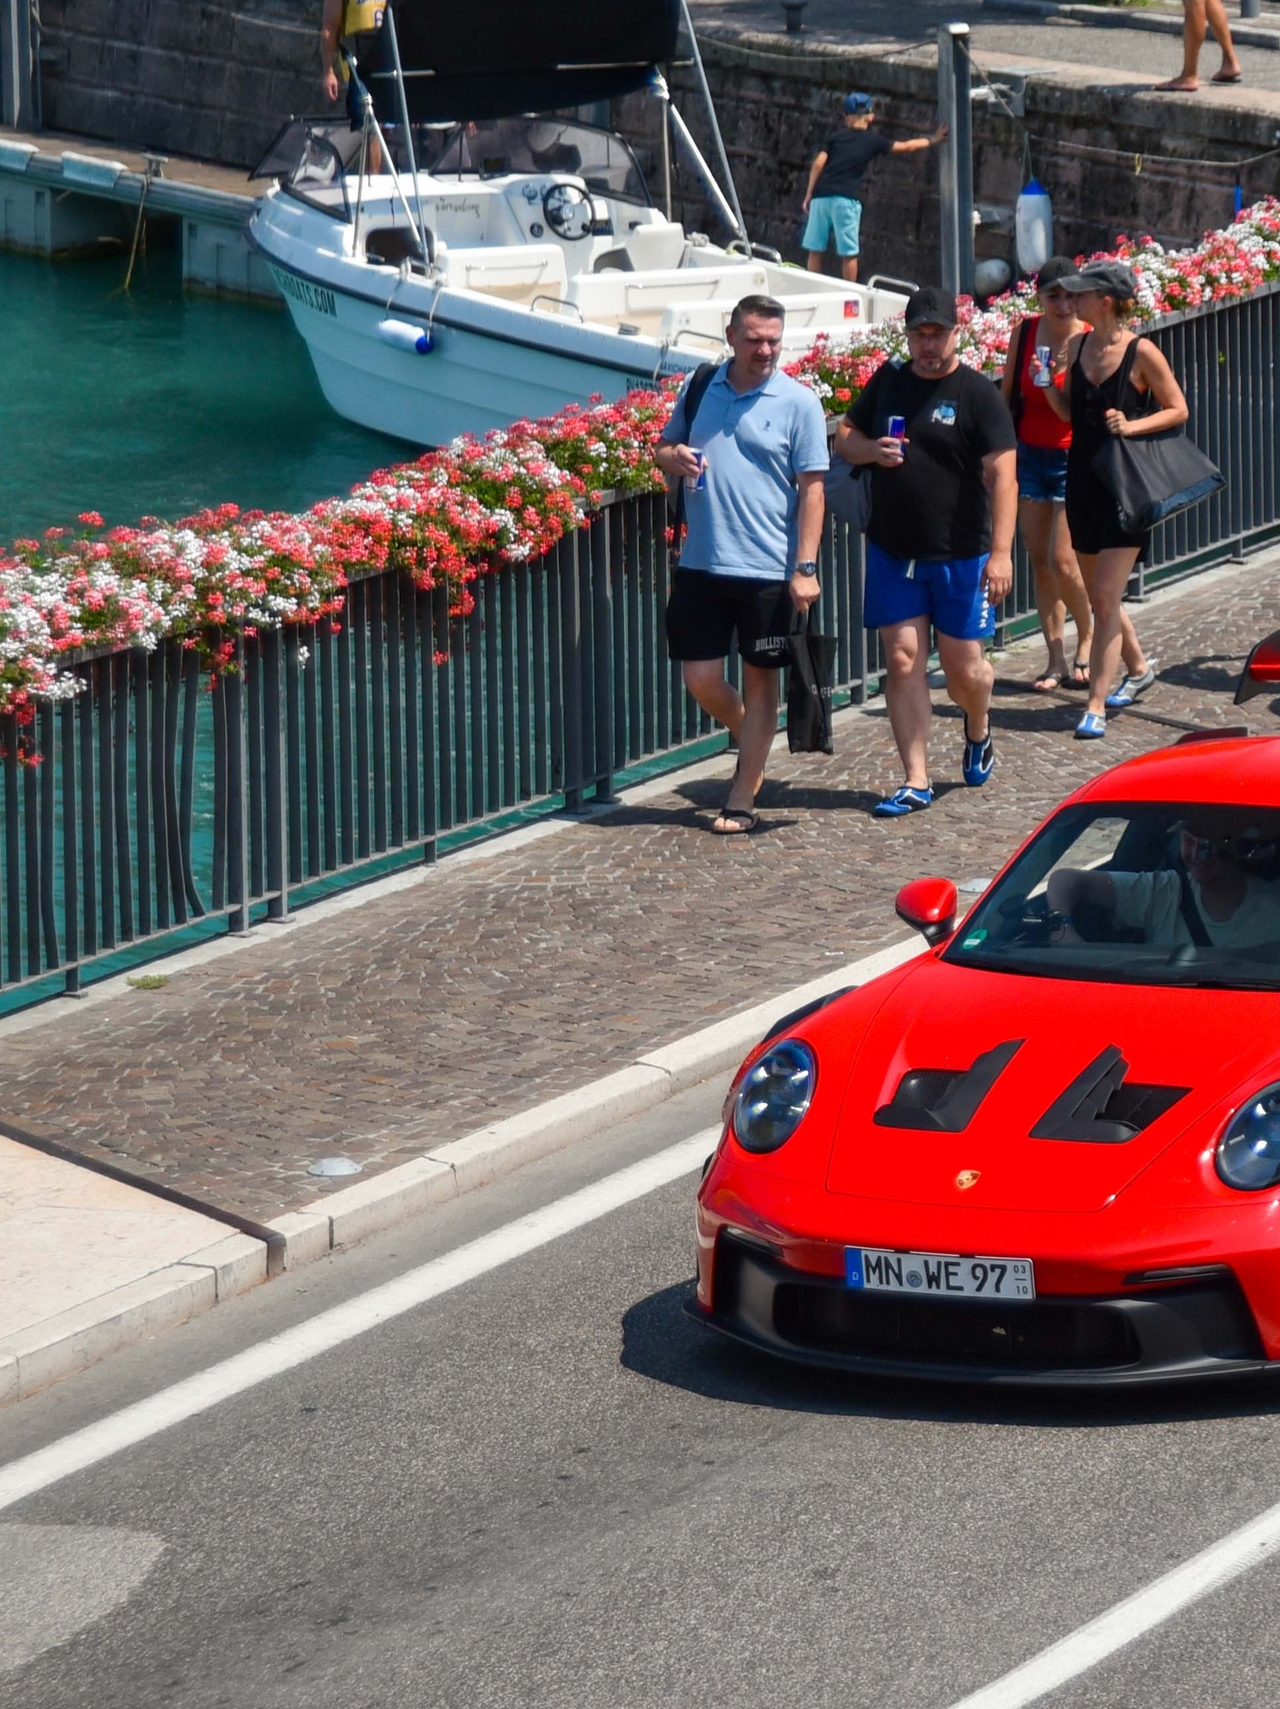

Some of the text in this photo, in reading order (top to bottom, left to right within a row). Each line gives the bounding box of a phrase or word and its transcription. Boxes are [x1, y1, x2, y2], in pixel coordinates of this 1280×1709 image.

[864, 1254, 903, 1287] MN
[923, 1259, 964, 1291] WE
[970, 1263, 1007, 1293] 97
[1013, 1264, 1026, 1274] 03
[1016, 1285, 1028, 1294] 10
